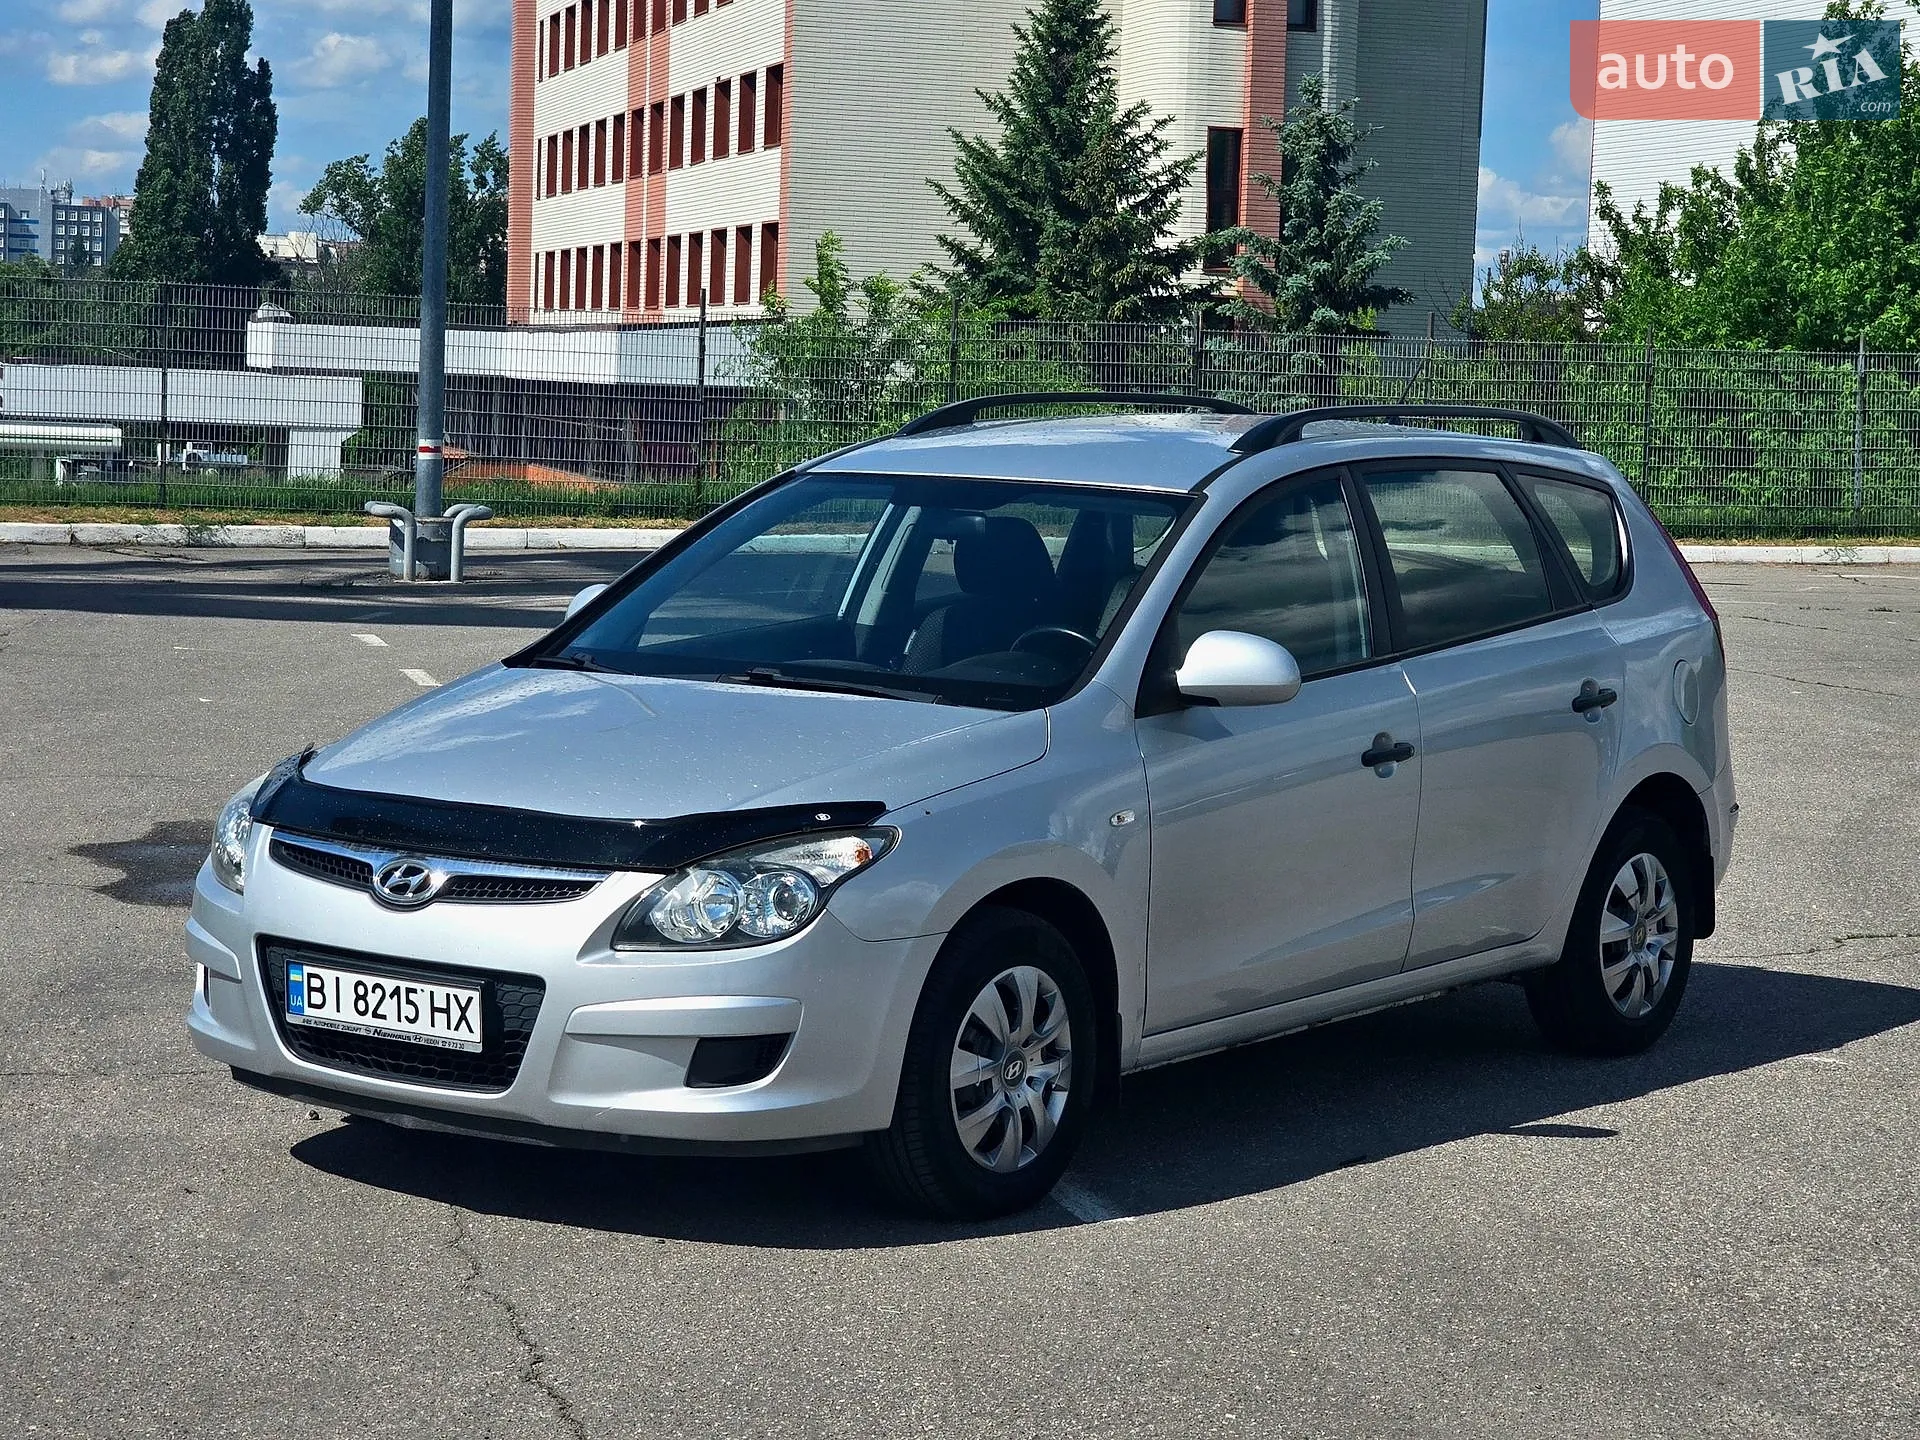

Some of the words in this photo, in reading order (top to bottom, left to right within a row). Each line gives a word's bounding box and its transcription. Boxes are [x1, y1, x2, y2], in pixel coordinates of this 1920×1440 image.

[290, 995, 303, 1007] UA
[353, 980, 420, 1025] 8215
[429, 990, 475, 1034] HX
